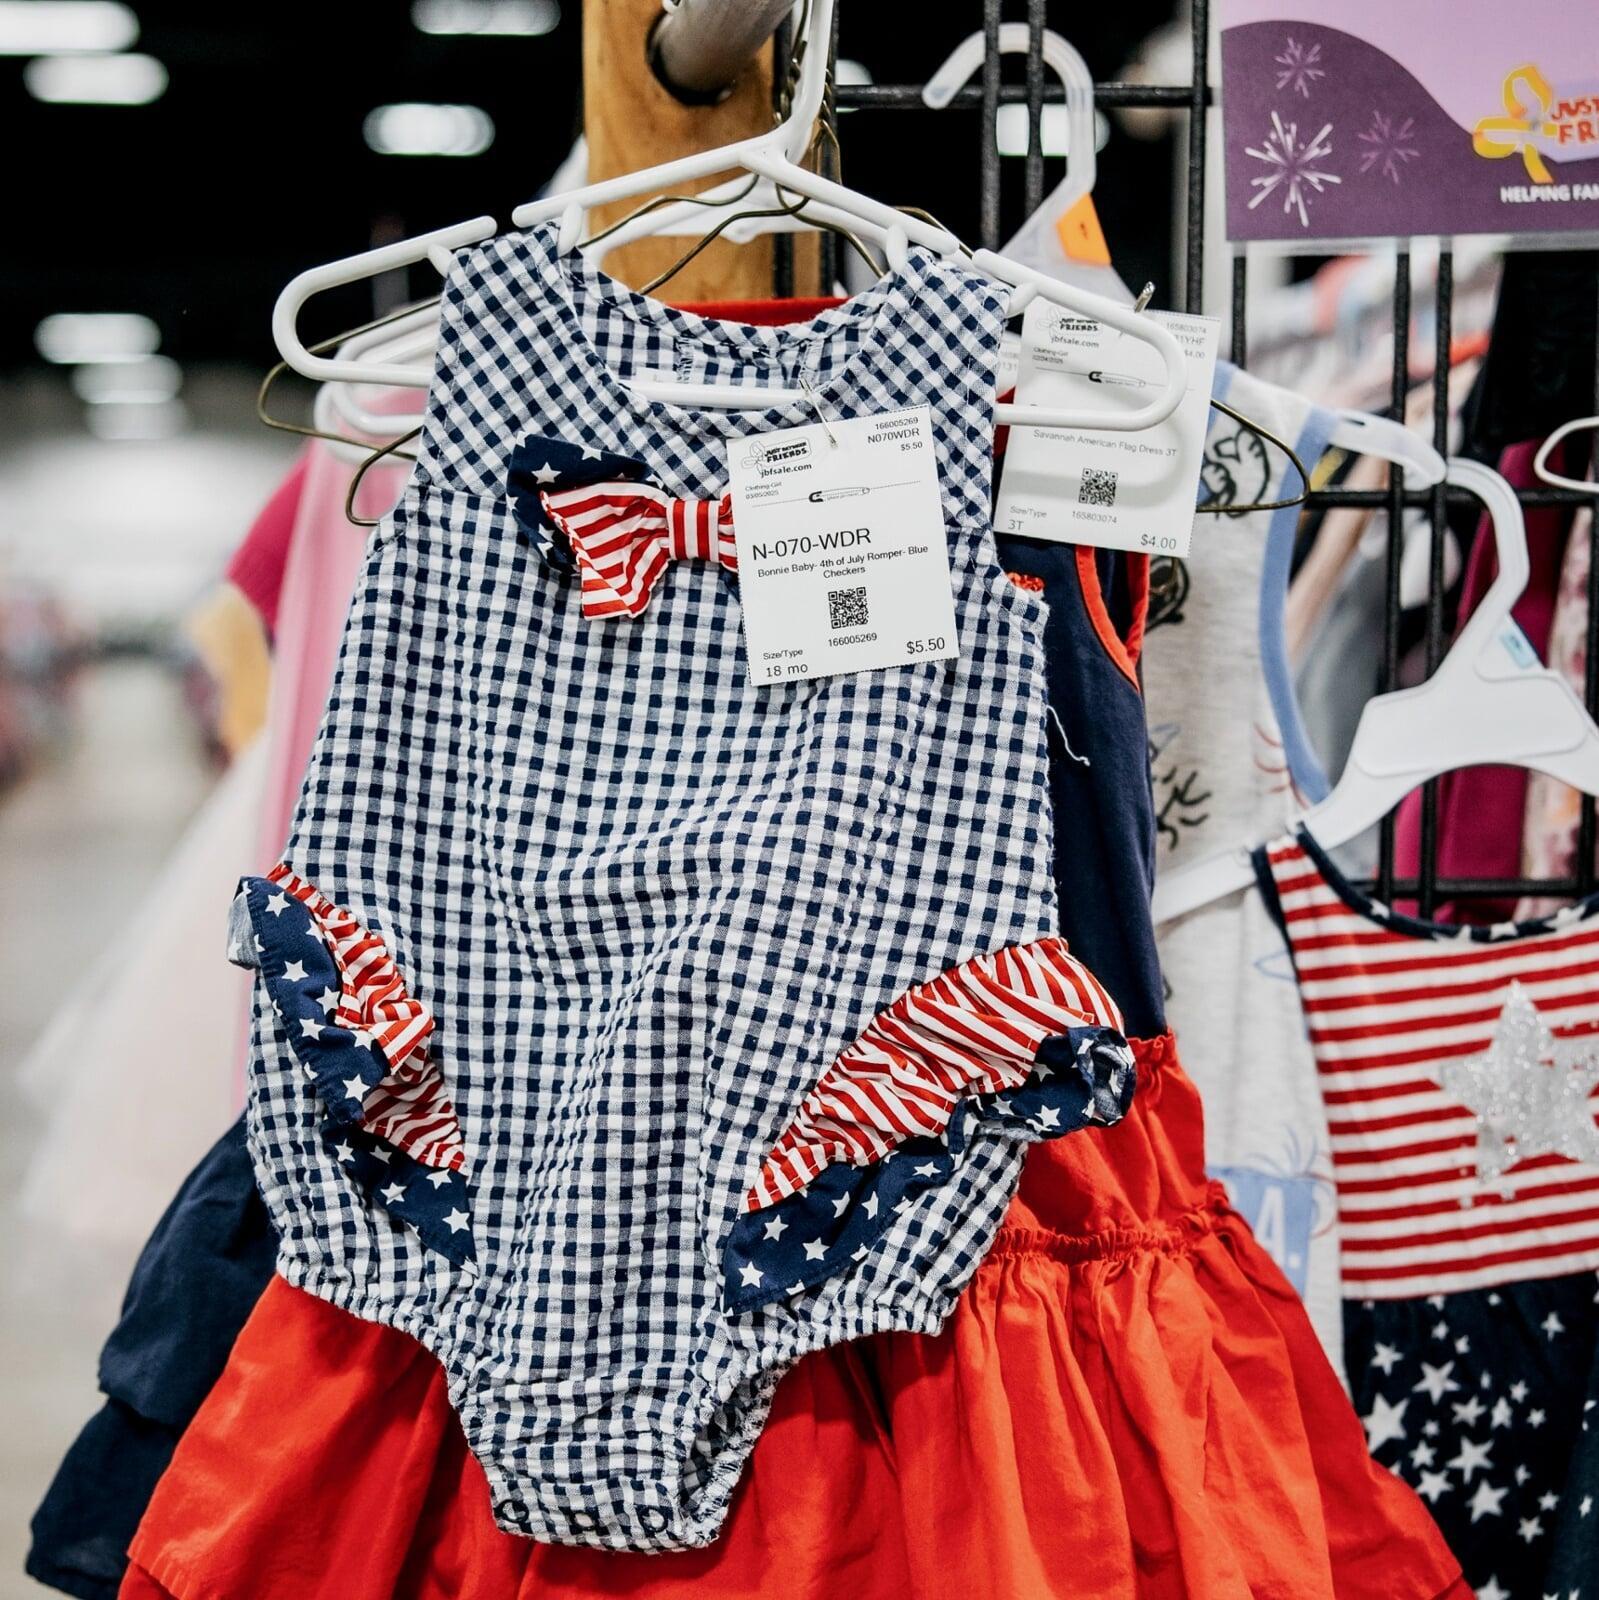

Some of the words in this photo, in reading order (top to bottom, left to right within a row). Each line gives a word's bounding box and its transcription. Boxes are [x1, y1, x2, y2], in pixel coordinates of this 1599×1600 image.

[1501, 185, 1570, 203] HELPING
[1060, 323, 1098, 331] FRIENDS
[1051, 335, 1100, 348] jbfsale.com
[875, 416, 919, 430] 166005269
[867, 427, 920, 444] N070WDR
[1033, 429, 1076, 443] Savannah
[1077, 436, 1117, 450] American
[1119, 440, 1137, 454] Flag
[1139, 443, 1164, 456] Dress
[1166, 447, 1177, 457] 3T
[765, 447, 780, 457] JUST
[900, 441, 923, 452] $5.50
[766, 447, 807, 463] FRIENDS
[761, 463, 812, 478] jbfsale.com
[1010, 505, 1047, 519] Size/Type
[1072, 510, 1117, 525] 165803074
[1008, 519, 1024, 531] 3T
[752, 528, 871, 560] N-070-WDR
[1141, 533, 1177, 551] $4.00
[758, 562, 790, 578] Bonnie
[791, 557, 818, 574] Baby-
[819, 556, 835, 568] 4th
[836, 555, 846, 567] of
[847, 552, 865, 565] July
[867, 549, 906, 561] Romper-
[908, 544, 929, 557] Blue
[823, 565, 866, 579] Checkers
[828, 632, 877, 648] 166005269
[906, 636, 946, 656] $5.50
[763, 647, 804, 661] Size/Type
[766, 665, 782, 678] 18
[788, 664, 808, 677] mo
